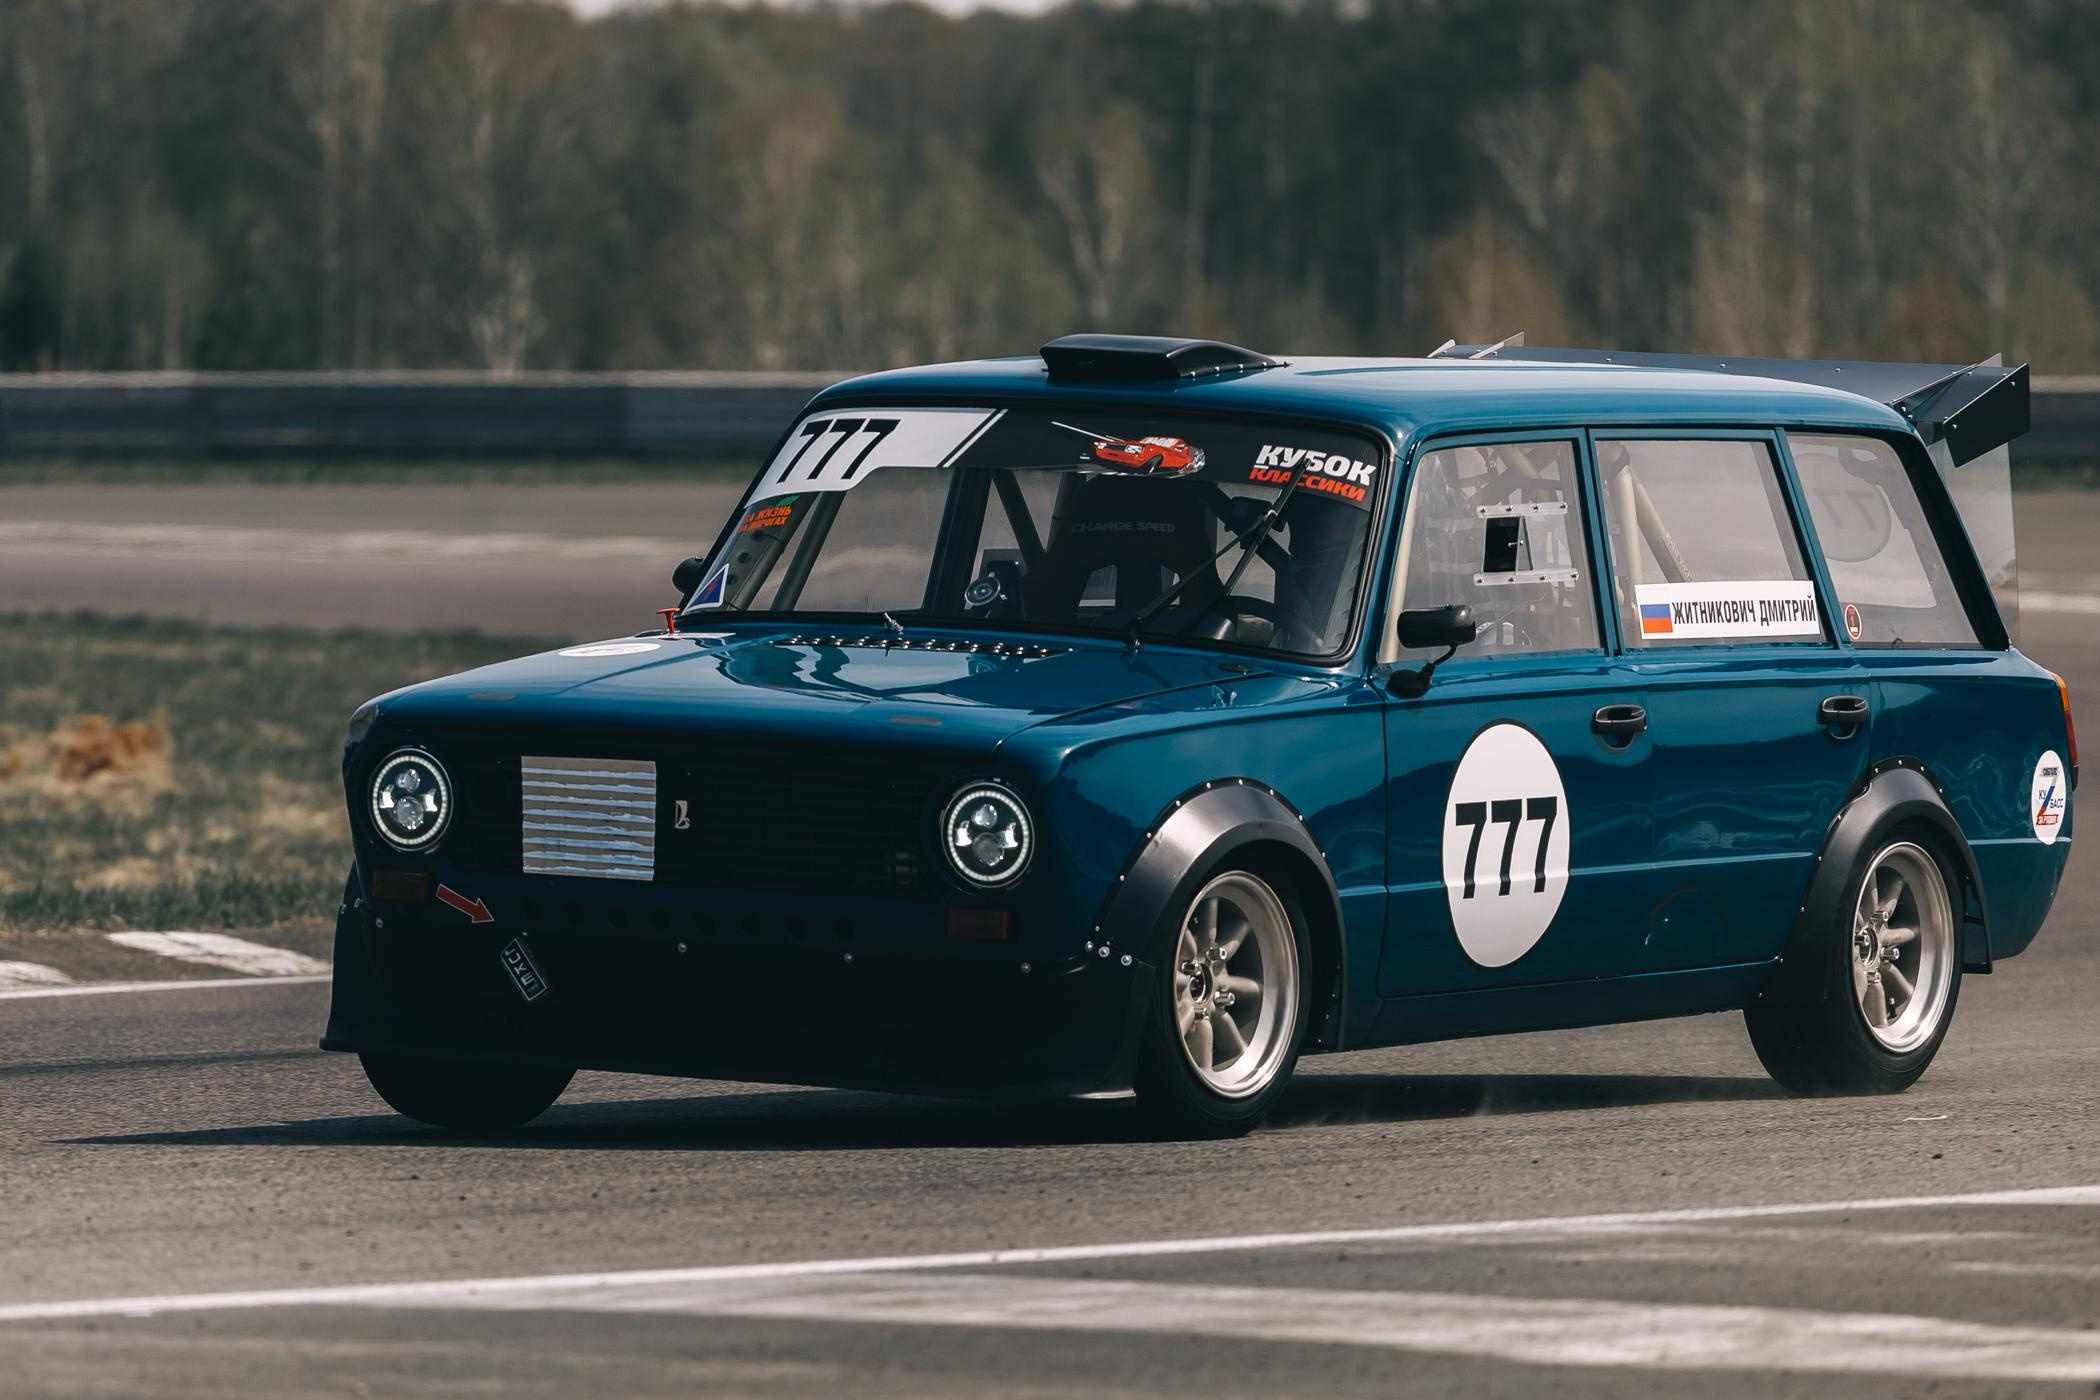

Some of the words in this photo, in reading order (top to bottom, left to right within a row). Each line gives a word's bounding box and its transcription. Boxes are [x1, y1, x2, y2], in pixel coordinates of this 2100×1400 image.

[776, 418, 901, 484] 777
[1254, 444, 1376, 487] КУБОК
[1071, 521, 1134, 533] CHARGE
[1136, 521, 1176, 533] SPEED
[1672, 600, 1757, 625] ЖИТНИКОВИЧ
[1760, 594, 1817, 627] ДМИТРИЙ
[1455, 796, 1558, 899] 777
